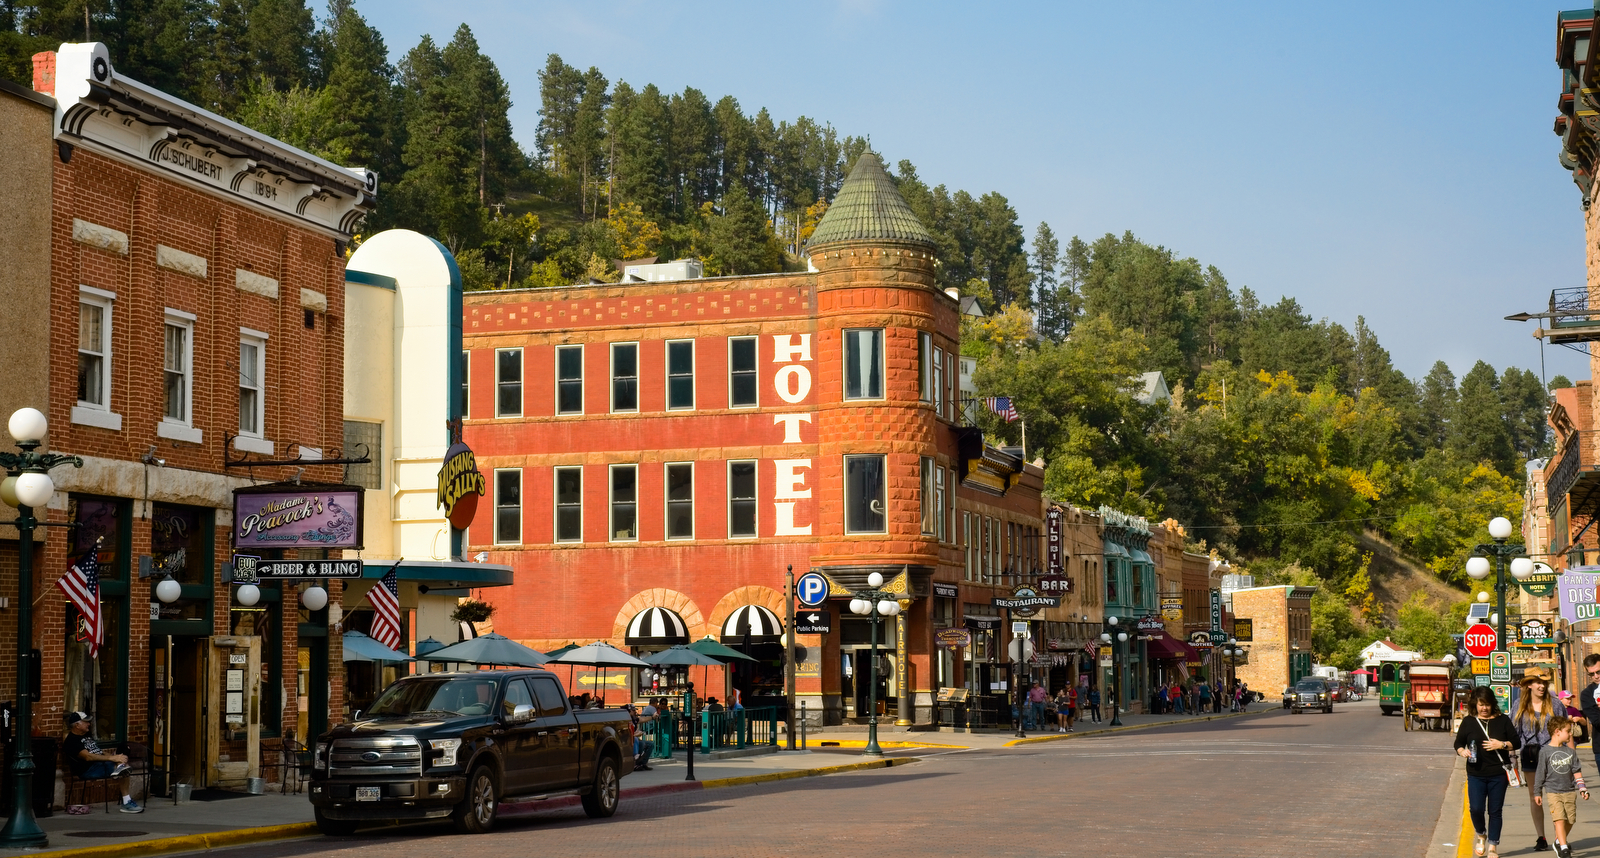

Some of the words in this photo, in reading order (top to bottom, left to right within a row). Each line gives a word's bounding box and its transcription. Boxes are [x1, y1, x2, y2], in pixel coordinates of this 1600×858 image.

[255, 181, 277, 200] 1894
[773, 333, 813, 536] HOTEL
[437, 451, 474, 510] MUSTANG
[446, 472, 485, 517] SALLY'S
[260, 496, 306, 516] Madame
[240, 496, 323, 538] Peacock's
[1050, 512, 1058, 542] WILD
[238, 557, 256, 570] BUD
[272, 563, 304, 575] BEER
[307, 563, 317, 575] &
[320, 562, 358, 574] BLING
[1050, 545, 1058, 575] BILL
[1041, 581, 1069, 591] BAR
[1564, 574, 1590, 585] PAM'S
[805, 578, 822, 602] P
[1568, 588, 1597, 603] DIS
[996, 598, 1056, 608] RESTAURANT
[811, 625, 829, 633] Parking
[937, 629, 968, 638] DEADWOOD
[1521, 626, 1547, 635] PINK
[1466, 634, 1495, 647] STOP
[897, 655, 906, 699] HOTEL
